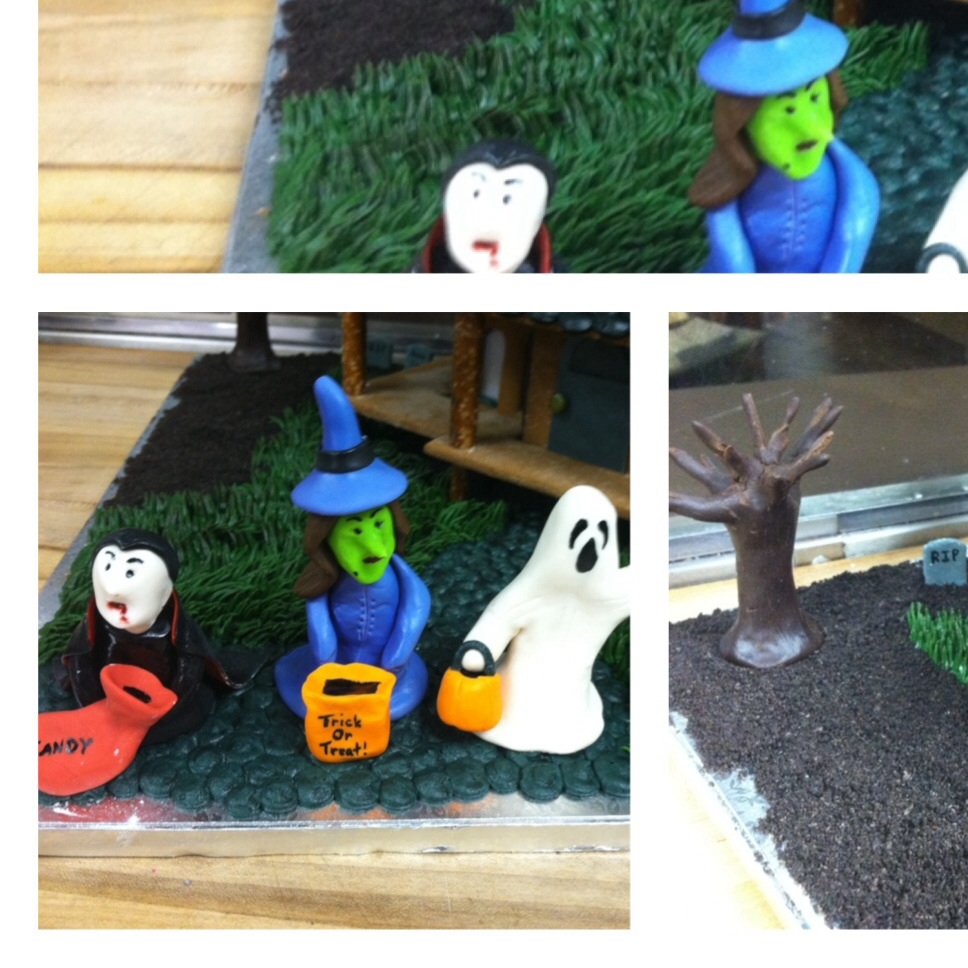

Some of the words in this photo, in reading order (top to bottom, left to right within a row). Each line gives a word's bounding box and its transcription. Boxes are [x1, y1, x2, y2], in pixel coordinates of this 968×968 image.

[930, 548, 960, 564] RIP
[317, 713, 362, 728] Trick
[332, 728, 353, 741] Or
[38, 736, 94, 757] ANDY
[318, 740, 368, 757] Treat!
